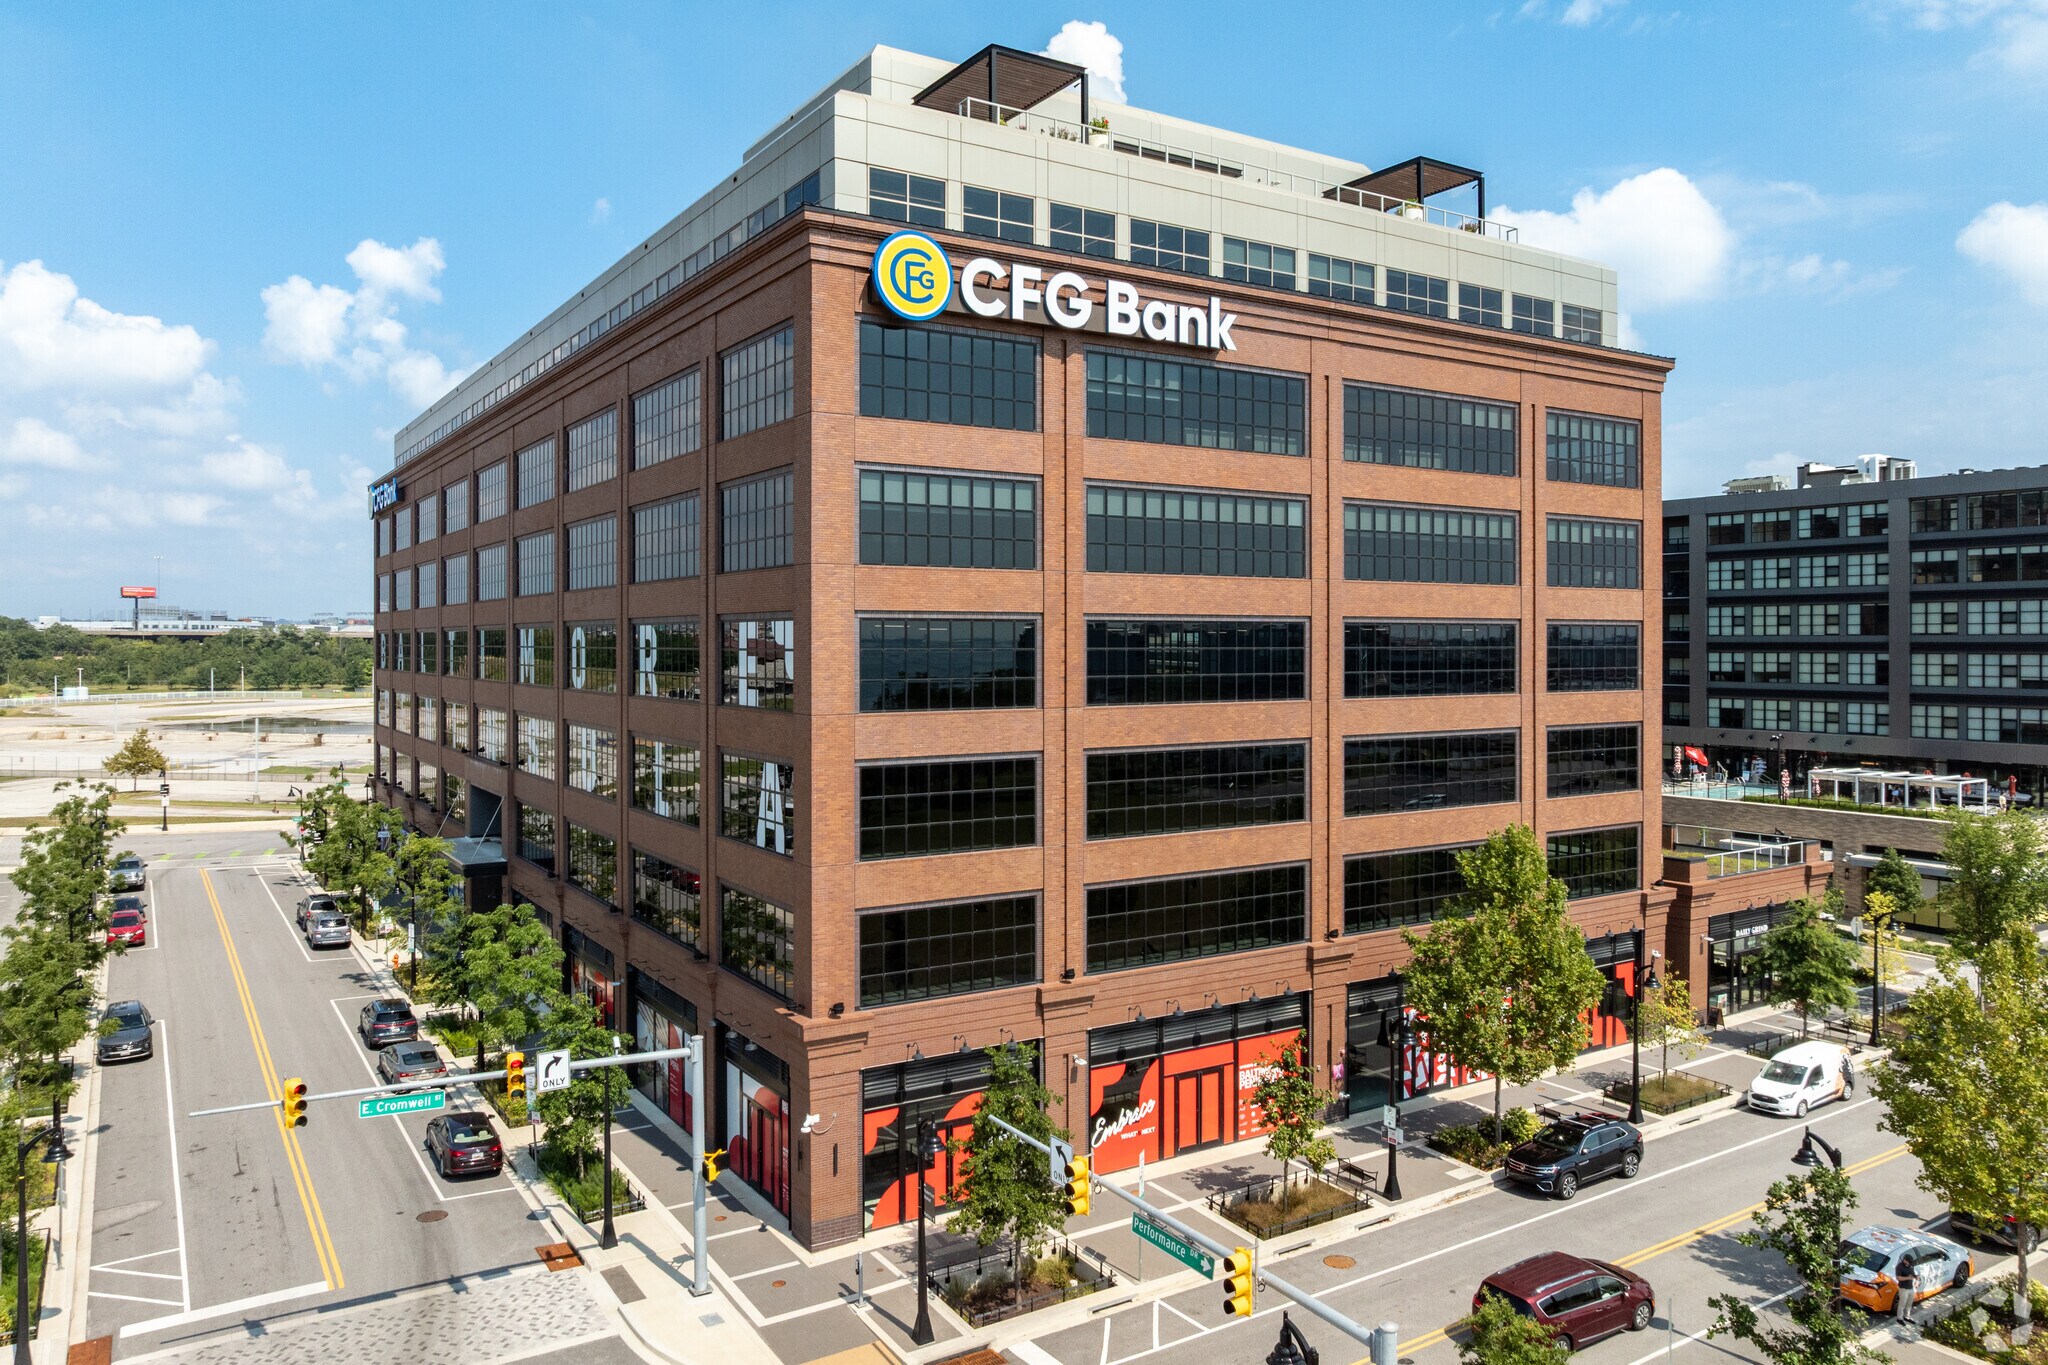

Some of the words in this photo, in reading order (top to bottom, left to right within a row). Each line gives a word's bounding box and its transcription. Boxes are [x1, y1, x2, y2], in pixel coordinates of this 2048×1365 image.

[959, 257, 1093, 330] CFG
[1106, 279, 1238, 352] Bank
[542, 1077, 566, 1088] ONLY
[362, 1103, 373, 1115] E.
[376, 1096, 431, 1113] Cromwell
[1091, 1098, 1156, 1149] Embrace
[1141, 1126, 1156, 1135] NEXT
[1133, 1217, 1186, 1258] Performance
[1189, 1248, 1199, 1260] DR
